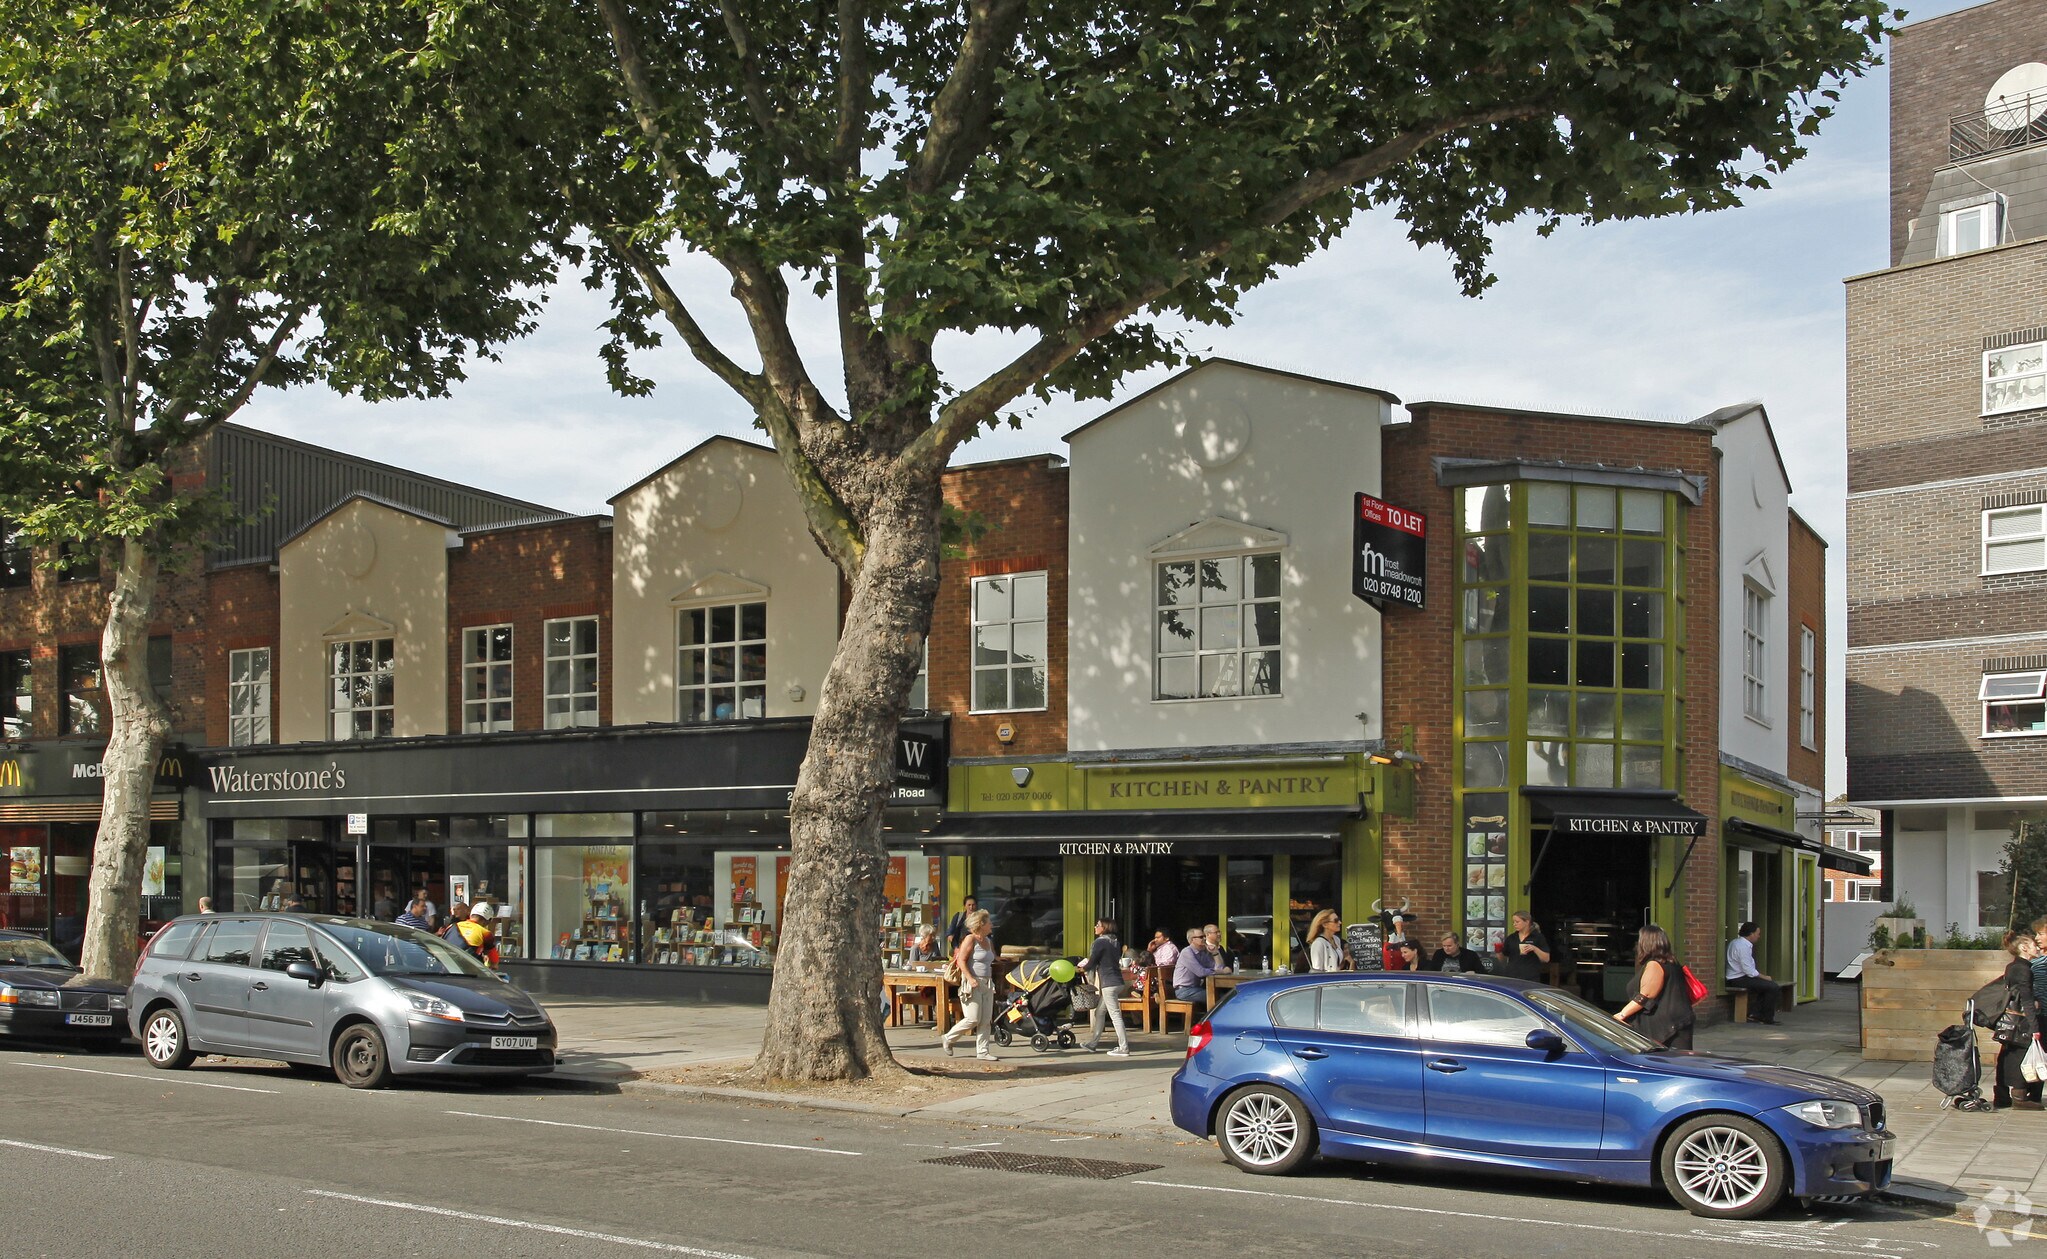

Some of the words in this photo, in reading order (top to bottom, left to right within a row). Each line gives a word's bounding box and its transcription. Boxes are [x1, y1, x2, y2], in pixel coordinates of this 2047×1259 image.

[1371, 499, 1384, 511] Floor
[1364, 508, 1381, 522] Offices
[1386, 507, 1402, 526] TO
[1404, 513, 1422, 532] LET
[1384, 556, 1399, 570] frost
[1363, 576, 1379, 593] 020
[1380, 581, 1401, 599] 8748
[1403, 587, 1422, 604] 1200
[902, 739, 928, 768] W
[208, 761, 346, 793] Waterstone's
[898, 788, 925, 799] Road
[1109, 779, 1209, 798] KITCHEN
[1215, 779, 1231, 796] &
[1238, 776, 1330, 796] PANTRY
[981, 793, 995, 801] Tel:
[996, 793, 1011, 801] 020
[1032, 791, 1053, 800] 0006
[1569, 818, 1629, 832] KITCHEN
[1632, 820, 1642, 833] &
[1645, 820, 1699, 835] PANTRY
[1059, 842, 1111, 855] KITCHEN
[1113, 842, 1123, 854] &
[1125, 842, 1174, 855] PANTRY
[71, 1015, 94, 1024] J456
[495, 1037, 518, 1048] SY07
[519, 1038, 534, 1048] UVL
